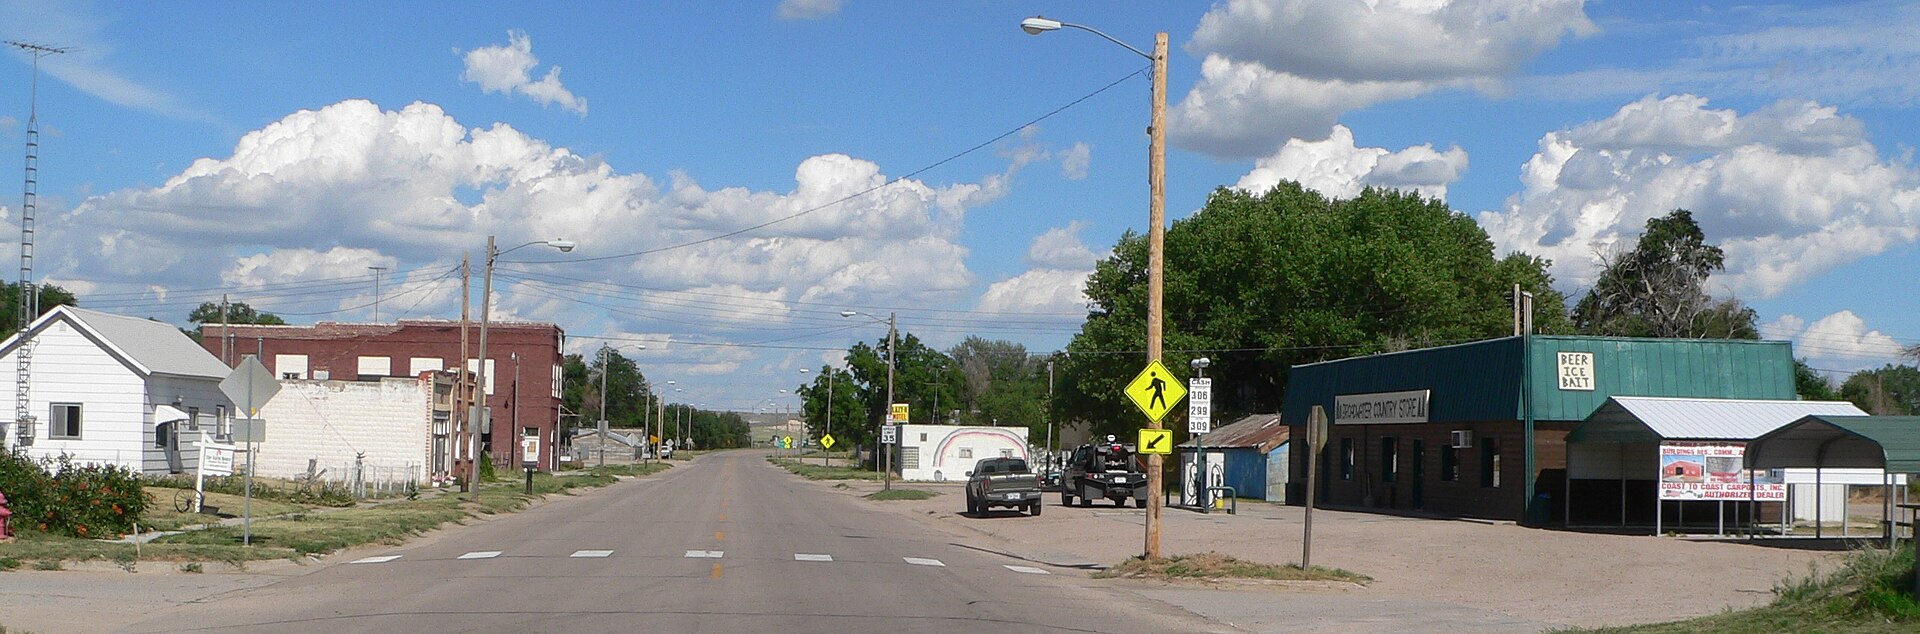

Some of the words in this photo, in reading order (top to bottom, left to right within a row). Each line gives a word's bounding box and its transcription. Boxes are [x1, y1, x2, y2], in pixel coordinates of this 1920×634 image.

[1561, 354, 1588, 365] BEER
[1563, 367, 1586, 376] ICE
[1562, 377, 1589, 388] BAIT
[1191, 390, 1208, 400] 306
[1190, 406, 1208, 416] 299
[1342, 401, 1372, 420] BROADWATER
[1373, 400, 1398, 419] COUNTRY
[1399, 397, 1417, 418] STORE
[1190, 421, 1207, 431] 309
[883, 434, 895, 442] 35
[1756, 491, 1785, 499] DEALER
